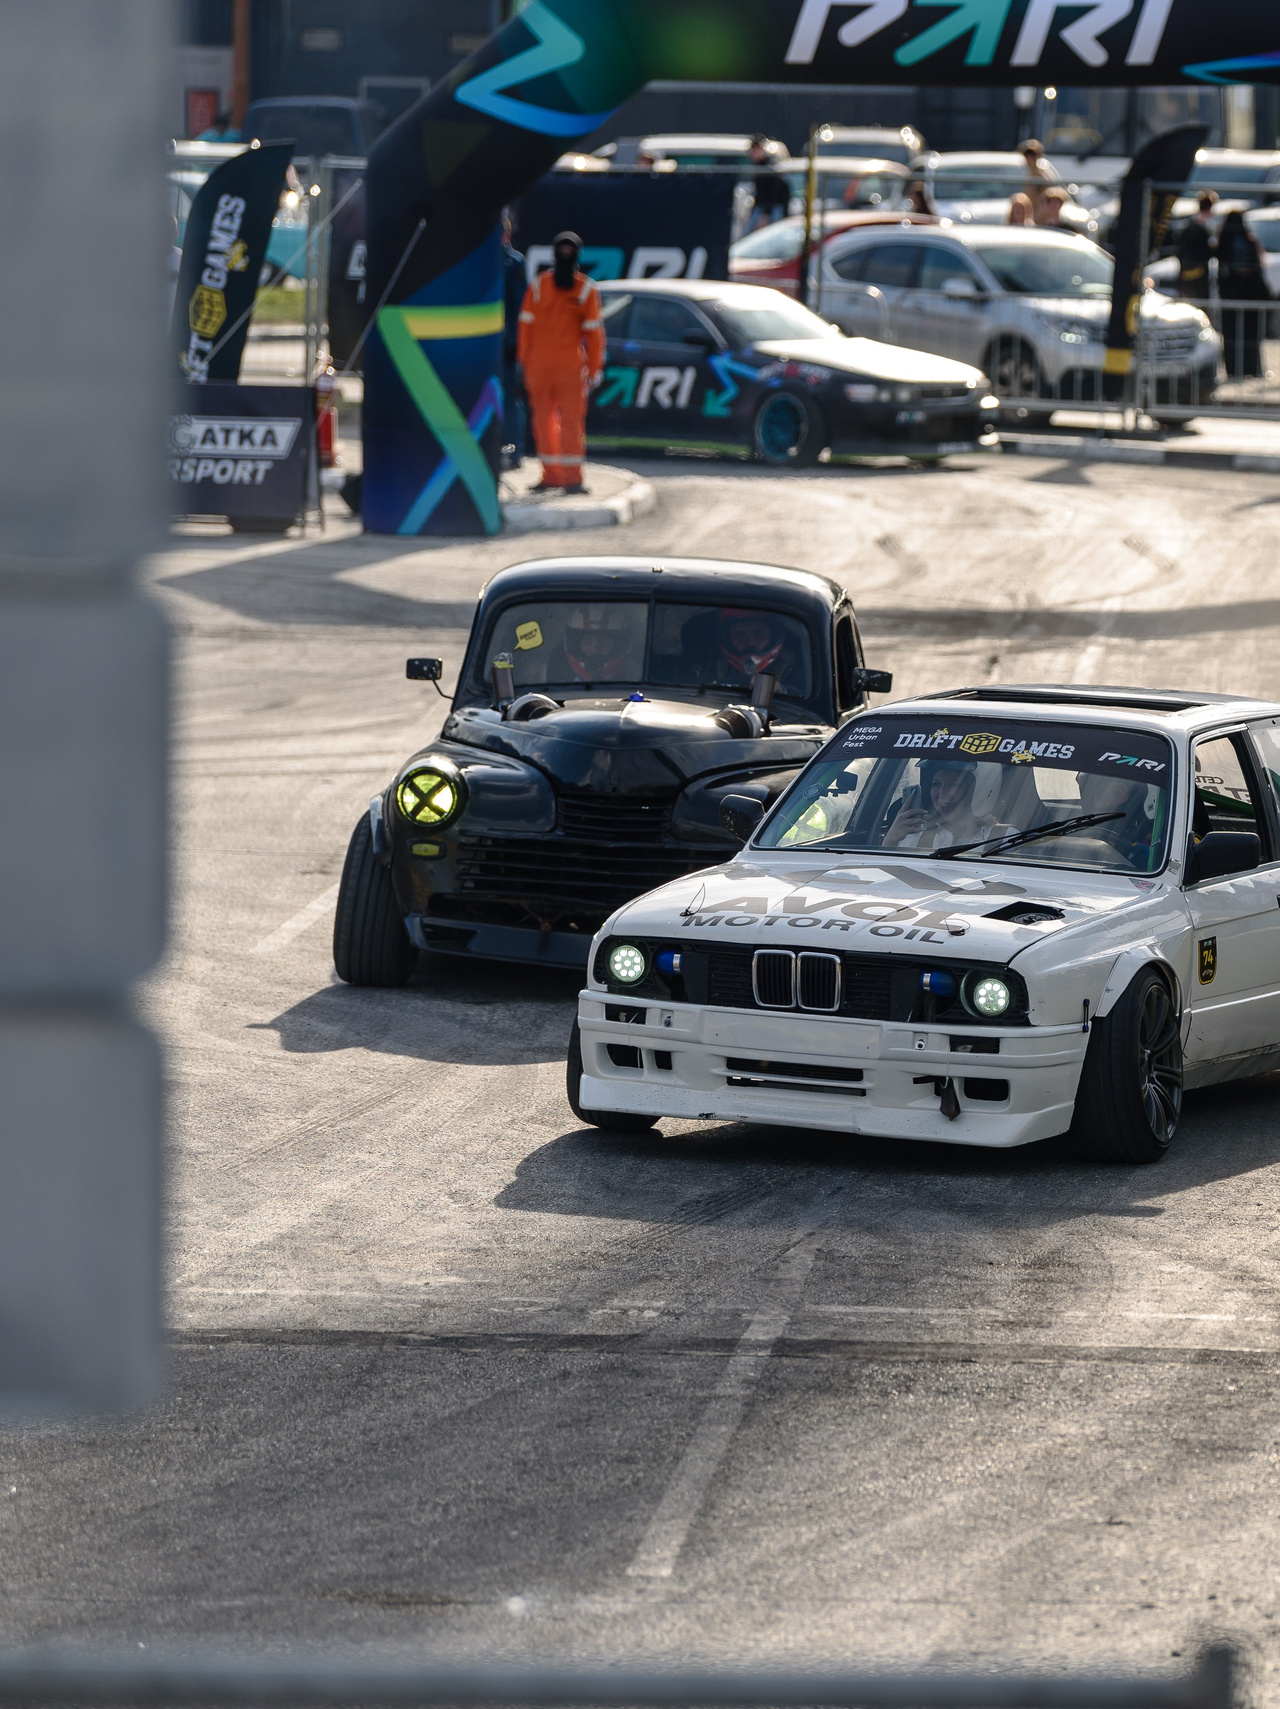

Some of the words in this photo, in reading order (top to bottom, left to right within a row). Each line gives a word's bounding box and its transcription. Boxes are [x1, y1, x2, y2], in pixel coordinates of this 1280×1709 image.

[202, 193, 247, 290] GAMES
[596, 366, 697, 409] ARI
[893, 733, 964, 749] DRIFT
[998, 738, 1076, 759] GAMES
[1097, 751, 1167, 772] PARI
[700, 896, 963, 932] AVOL
[681, 915, 857, 932] MOTOR
[868, 926, 945, 945] OIL
[1203, 949, 1214, 965] 74
